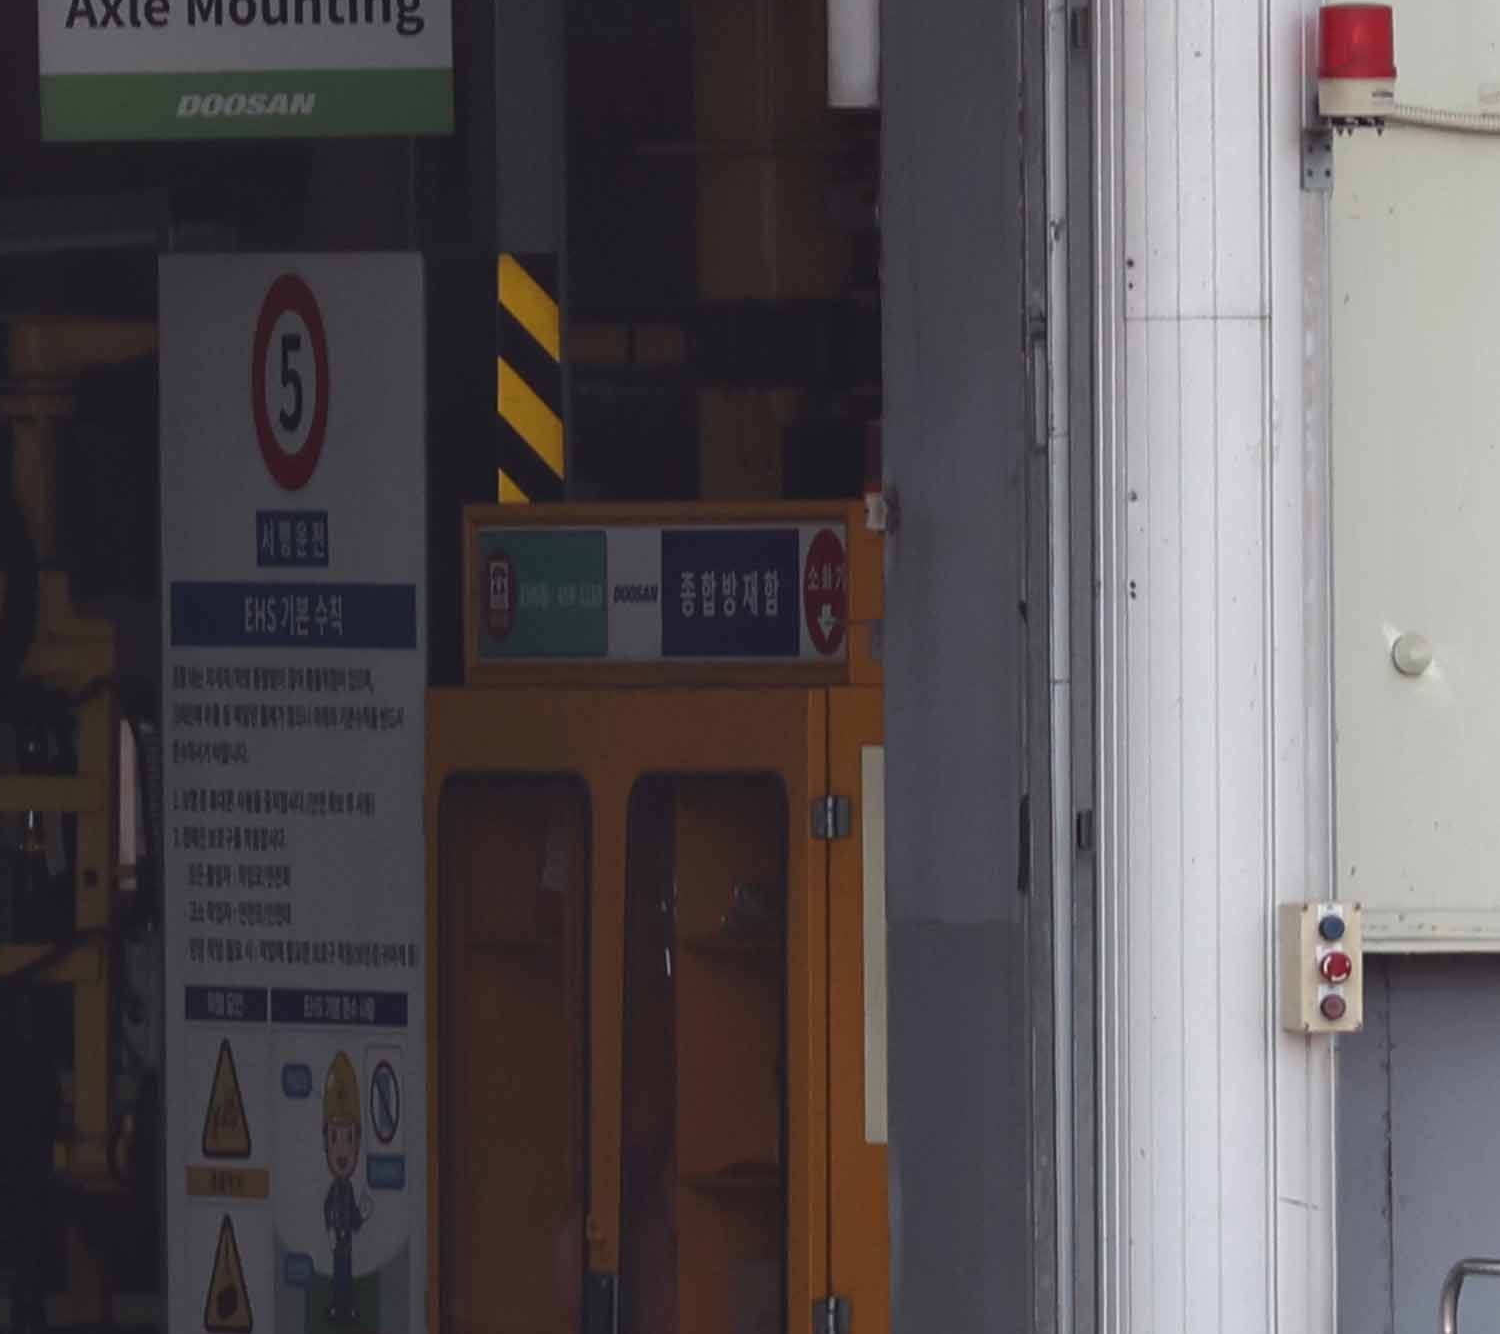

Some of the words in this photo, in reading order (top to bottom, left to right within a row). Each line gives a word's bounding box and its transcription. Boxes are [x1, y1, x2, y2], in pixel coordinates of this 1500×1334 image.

[175, 93, 316, 119] DOOSAN
[279, 333, 304, 433] 5
[613, 584, 659, 604] DOOSAN
[679, 569, 779, 618] 종합방재함
[244, 595, 277, 634] EHS
[280, 594, 312, 638] 기본
